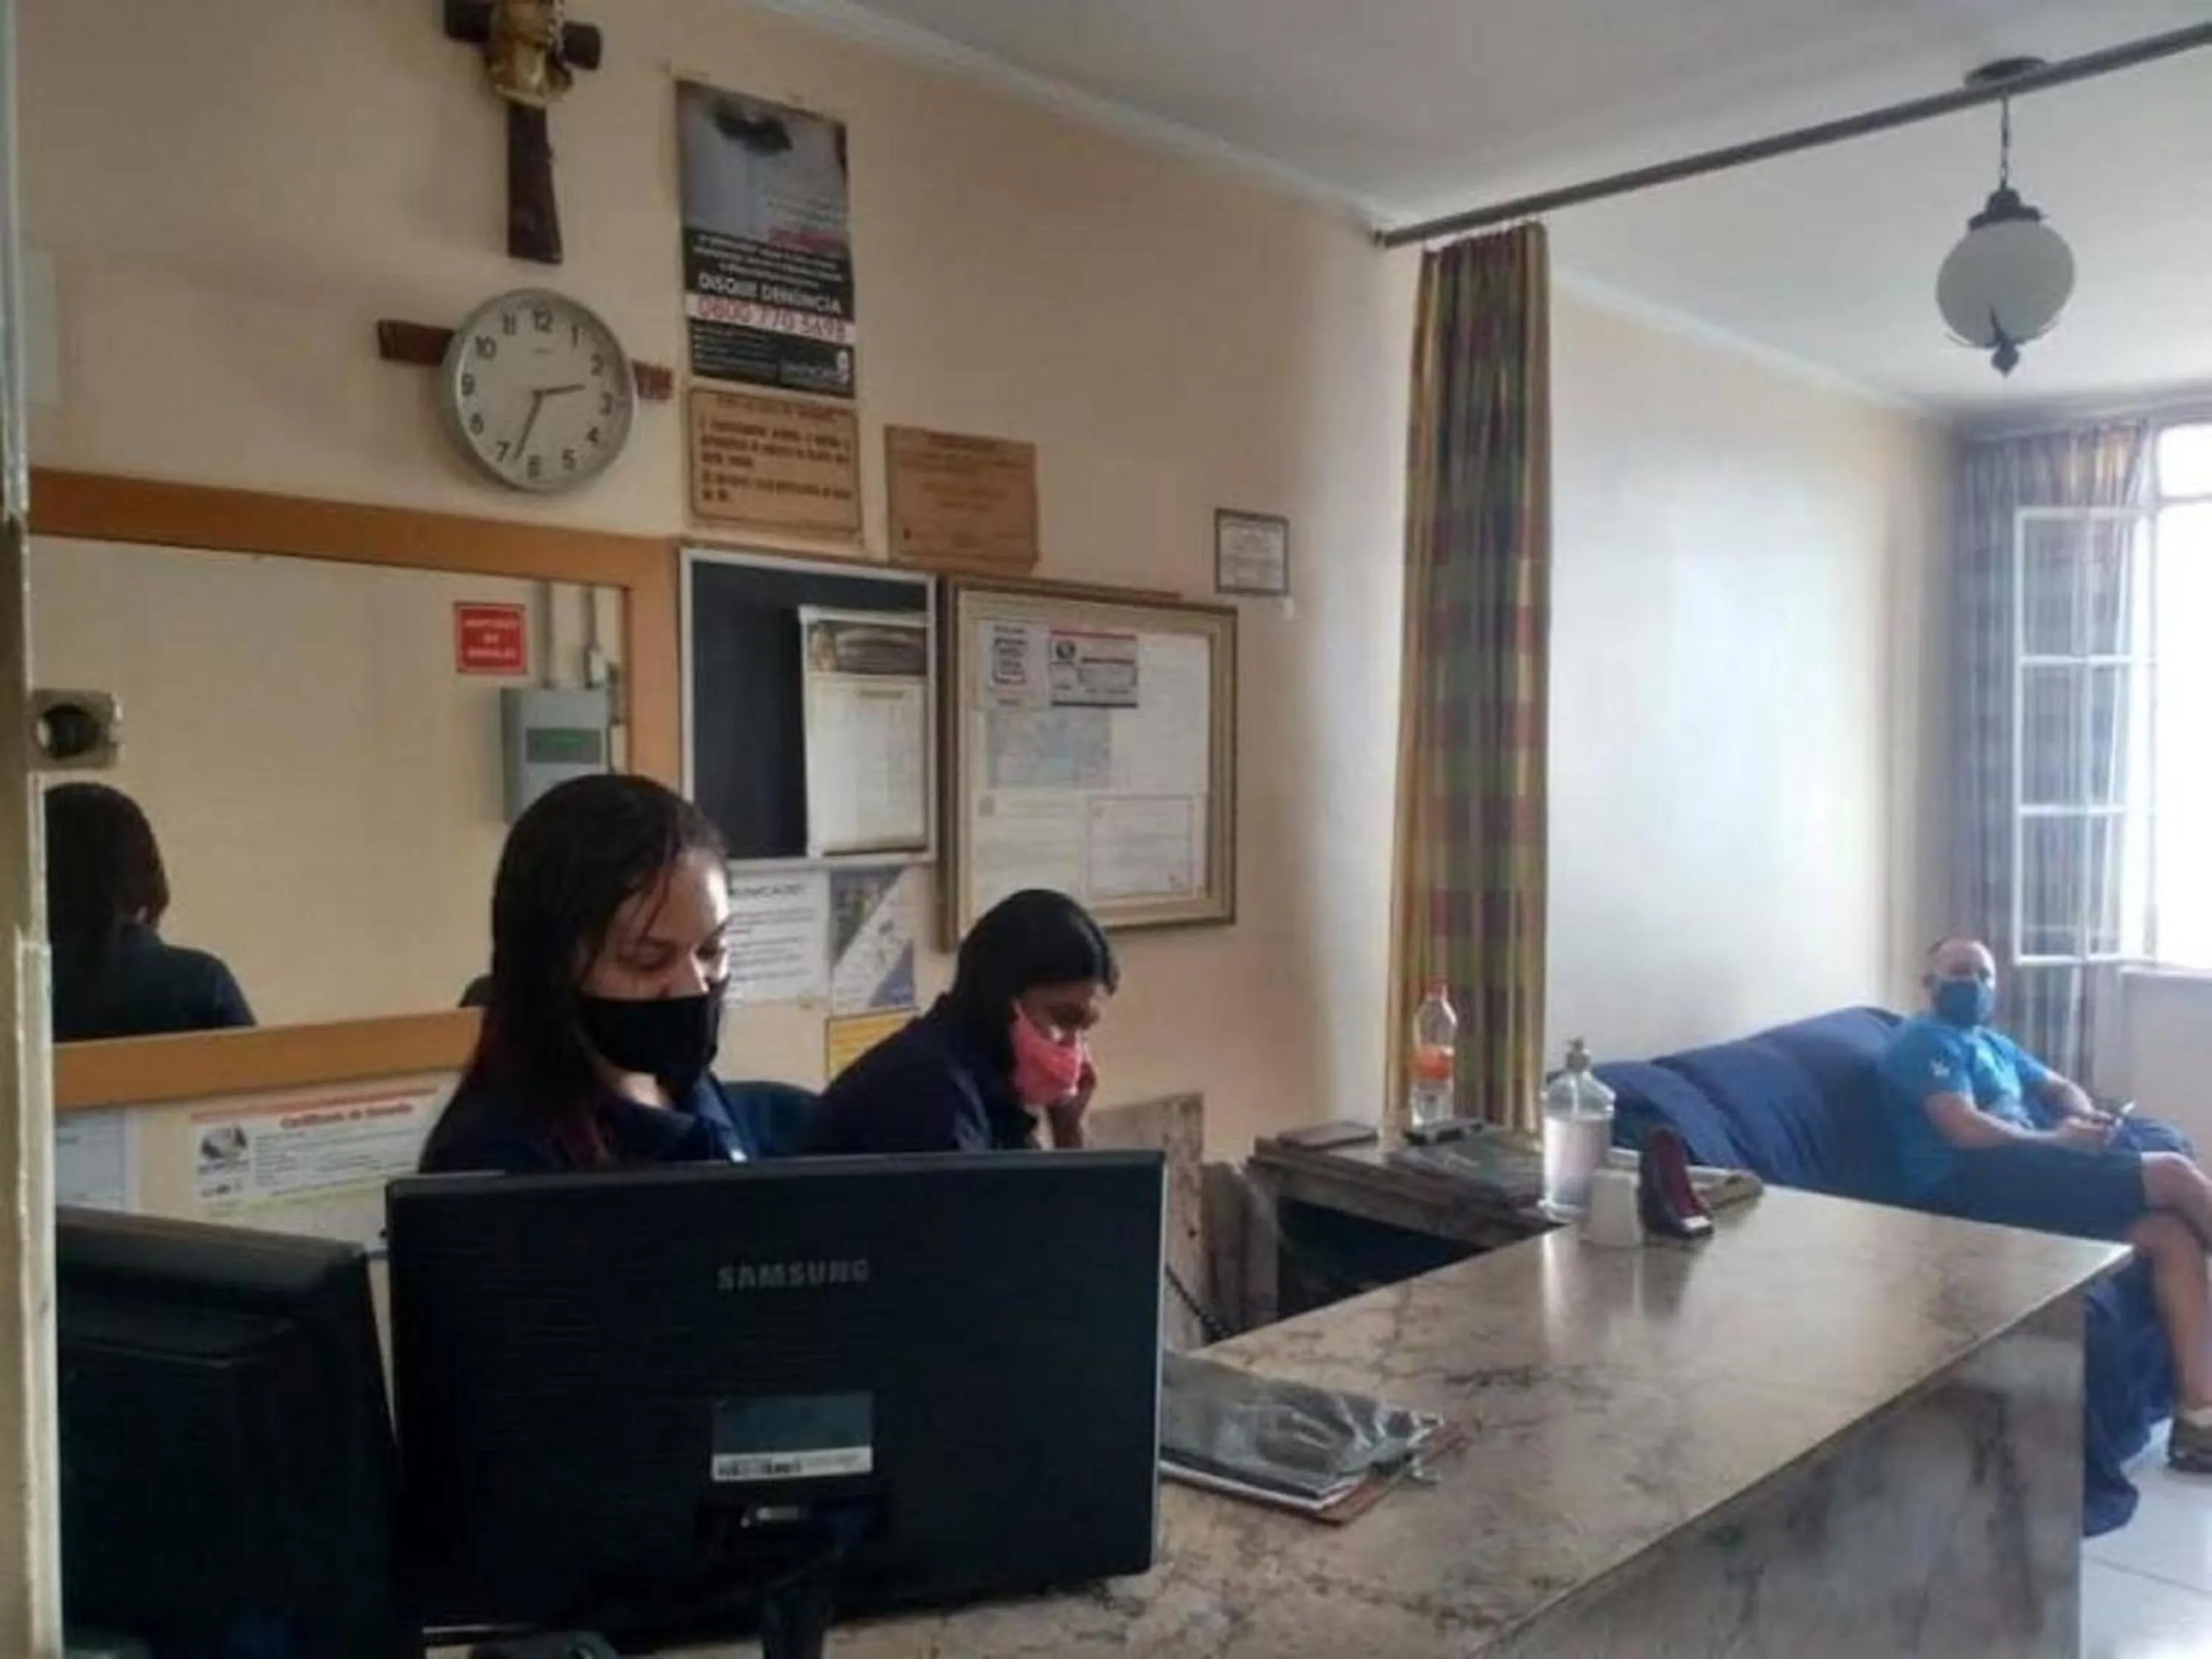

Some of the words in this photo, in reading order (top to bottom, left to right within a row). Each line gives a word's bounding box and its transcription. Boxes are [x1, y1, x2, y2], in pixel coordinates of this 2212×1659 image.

[700, 272, 757, 295] DISQUE
[698, 296, 752, 323] 0800
[501, 316, 517, 335] 11
[532, 310, 553, 333] 12
[475, 336, 497, 359] 10
[571, 326, 580, 349] 1
[590, 355, 604, 377] 2
[462, 374, 476, 397] 9
[599, 394, 612, 415] 3
[470, 414, 484, 435] 8
[585, 427, 598, 445] 4
[496, 442, 511, 462] 7
[562, 449, 575, 470] 5
[526, 455, 541, 479] 6
[717, 1259, 869, 1290] SAMSUNG
